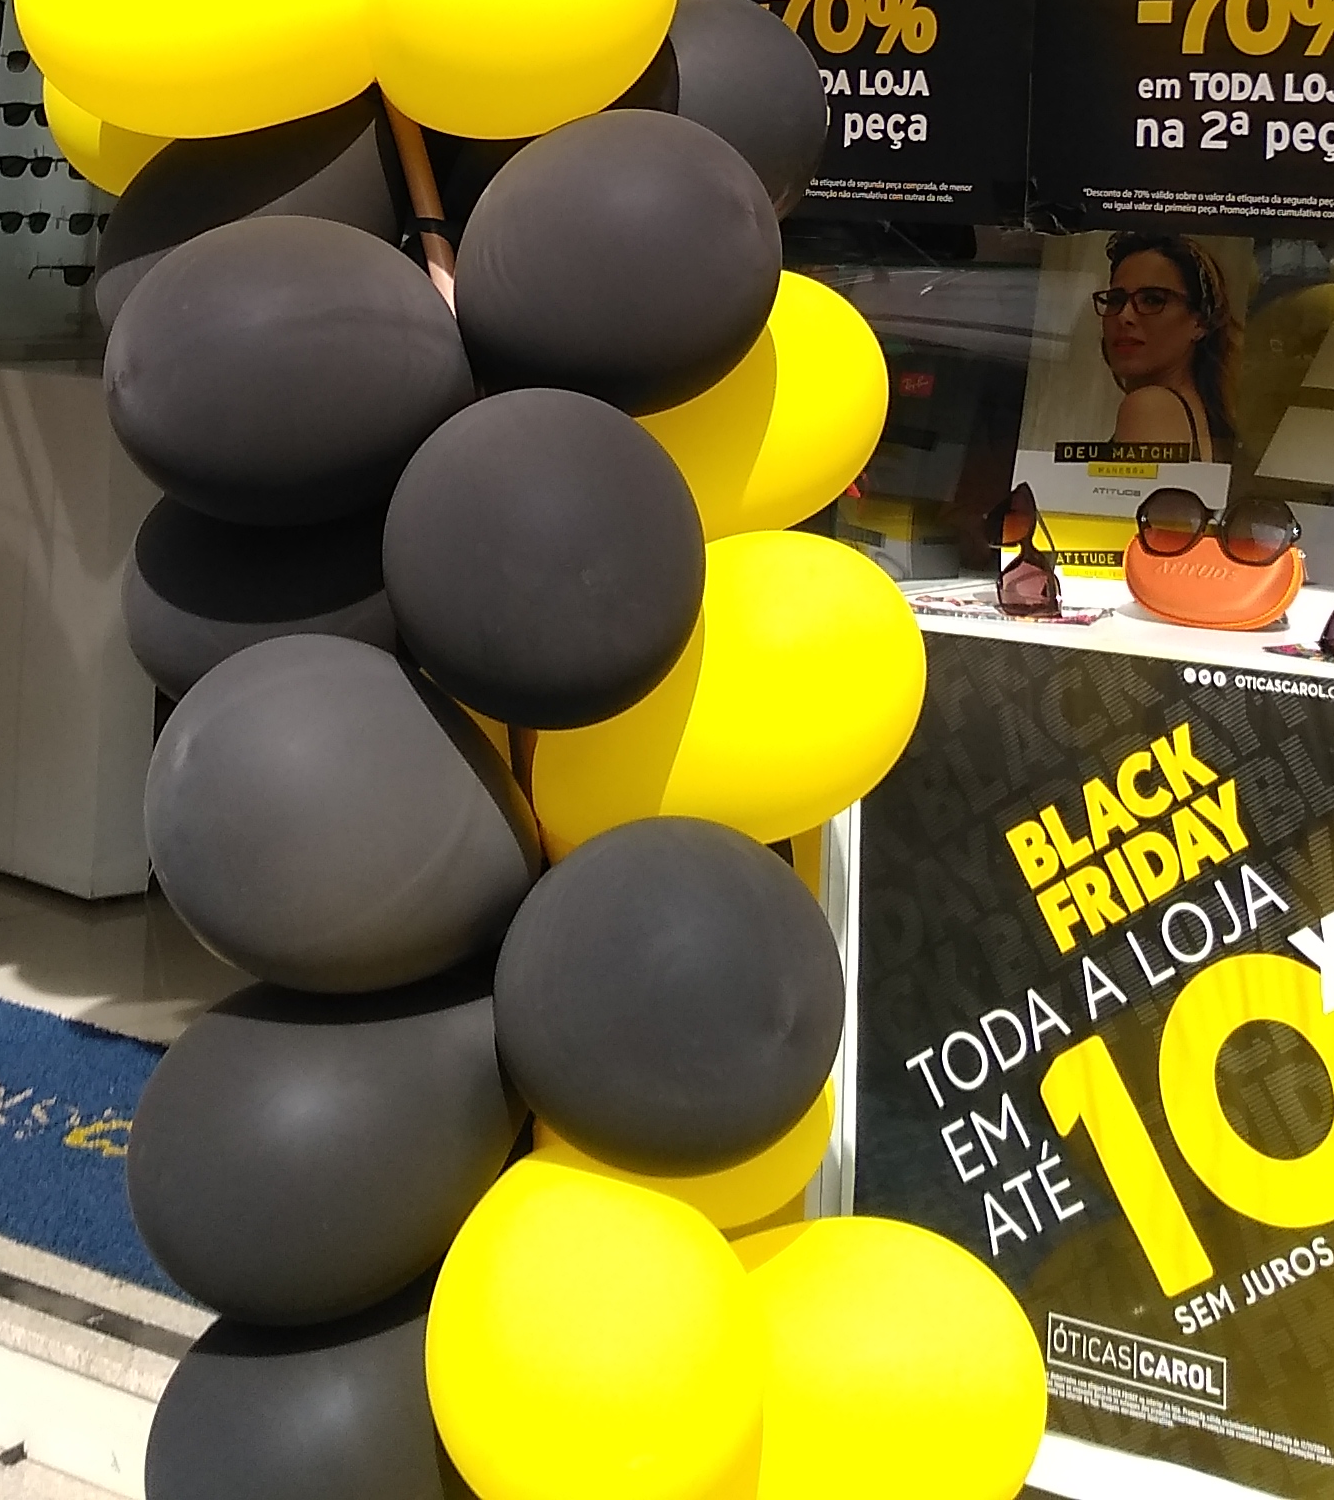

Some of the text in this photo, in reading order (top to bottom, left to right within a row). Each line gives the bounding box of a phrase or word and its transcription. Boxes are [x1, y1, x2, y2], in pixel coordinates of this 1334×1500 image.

[1063, 445, 1099, 460] DEU
[1056, 552, 1116, 565] ATITUDE
[1005, 722, 1219, 890] BLACK
[1036, 779, 1250, 954] FRIDAY
[906, 864, 1290, 1108] TODA A LOJA
[941, 1093, 1032, 1183] EM
[983, 1140, 1085, 1256] ATÉ
[1174, 1285, 1236, 1335] SEM
